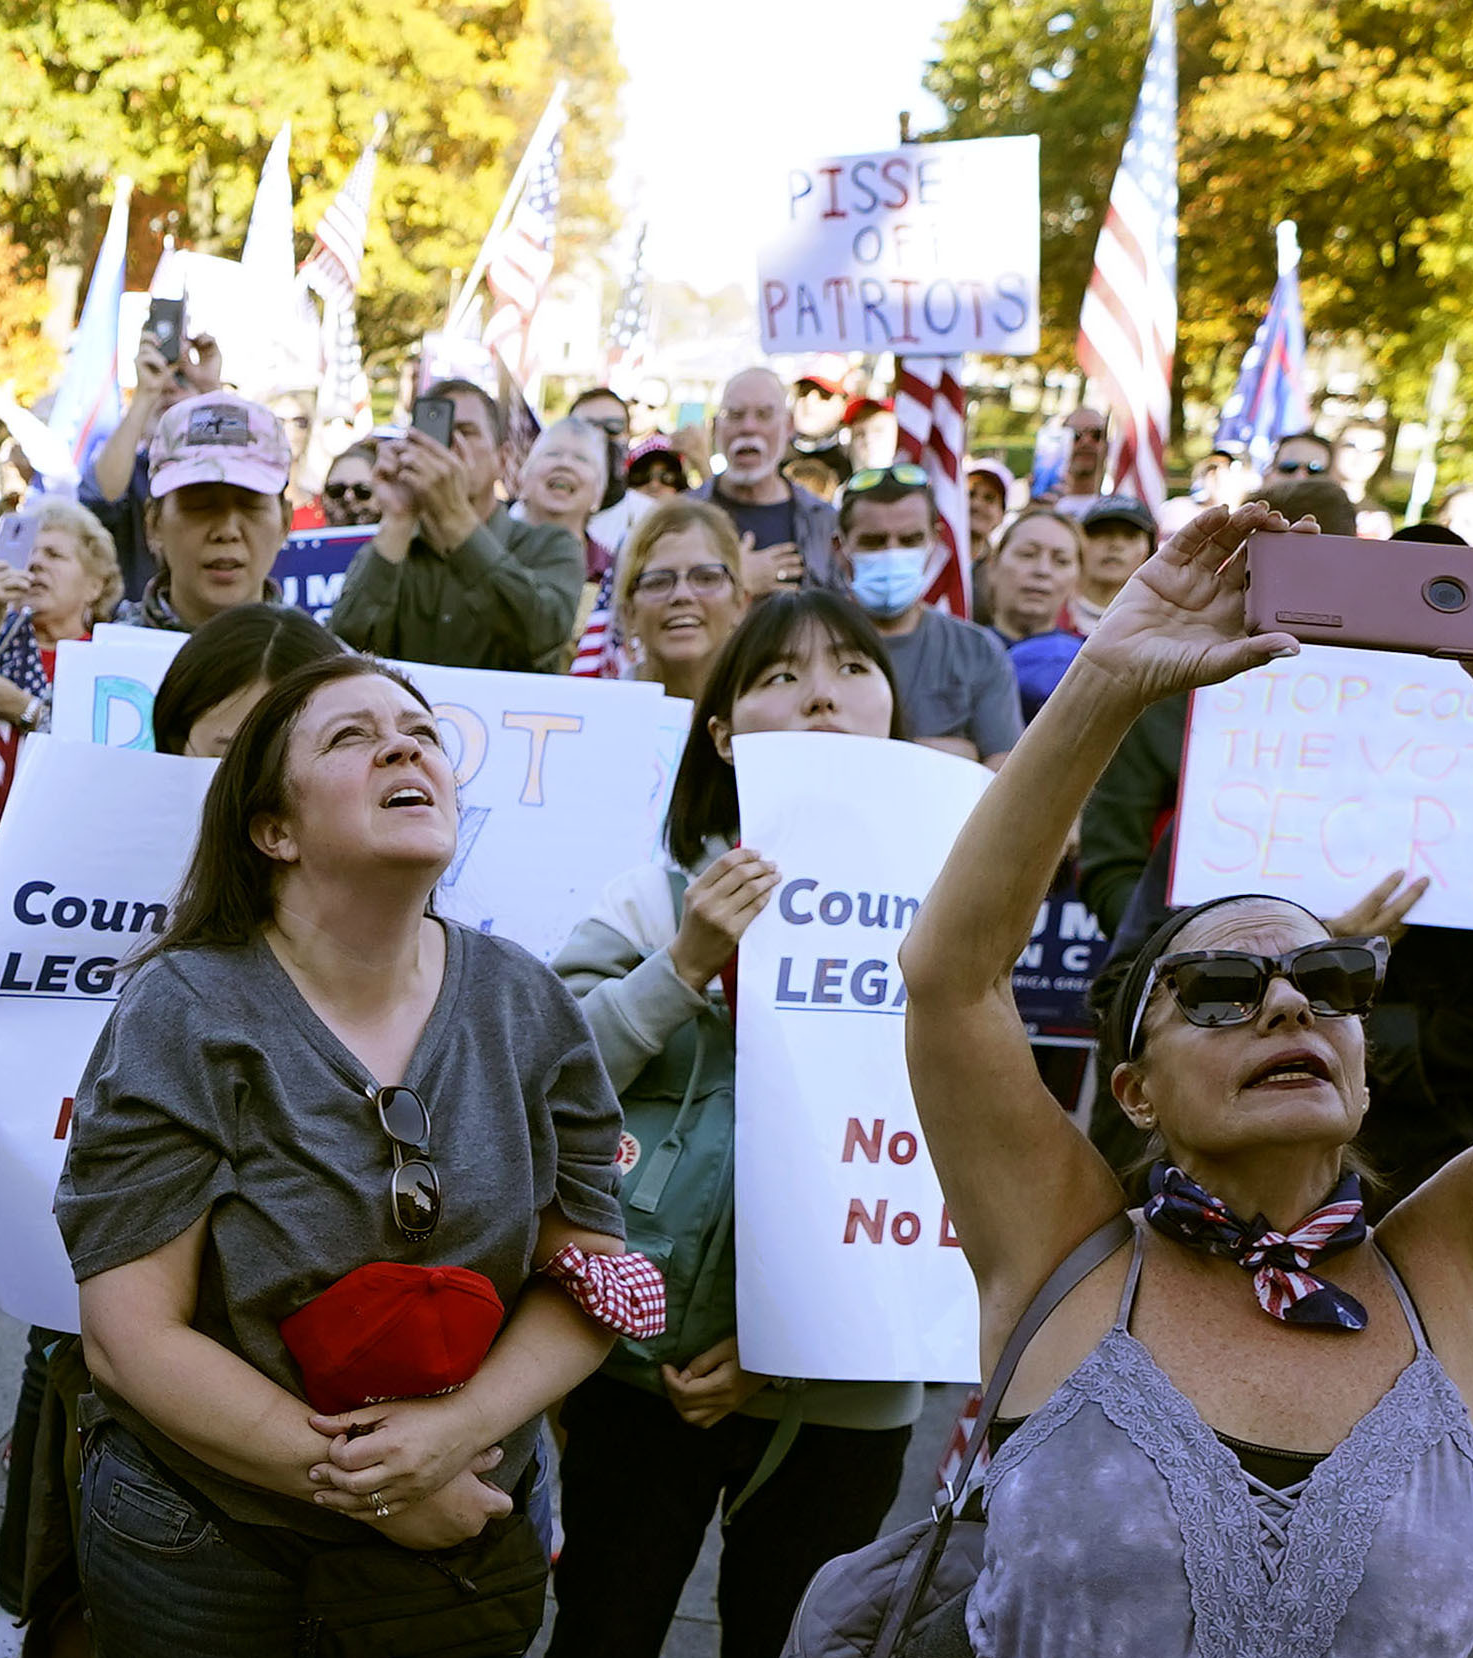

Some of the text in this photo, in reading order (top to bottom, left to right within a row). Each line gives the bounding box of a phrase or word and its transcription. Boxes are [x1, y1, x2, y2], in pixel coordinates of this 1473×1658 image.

[788, 158, 947, 220] PISSE
[763, 273, 1029, 344] PATRIOTS
[1214, 672, 1372, 714] STOP
[1221, 729, 1336, 769] THE
[14, 880, 168, 934] Coun
[779, 878, 920, 929] Coun
[0, 952, 126, 995] LEG
[841, 1117, 918, 1165] No
[842, 1198, 922, 1246] No
